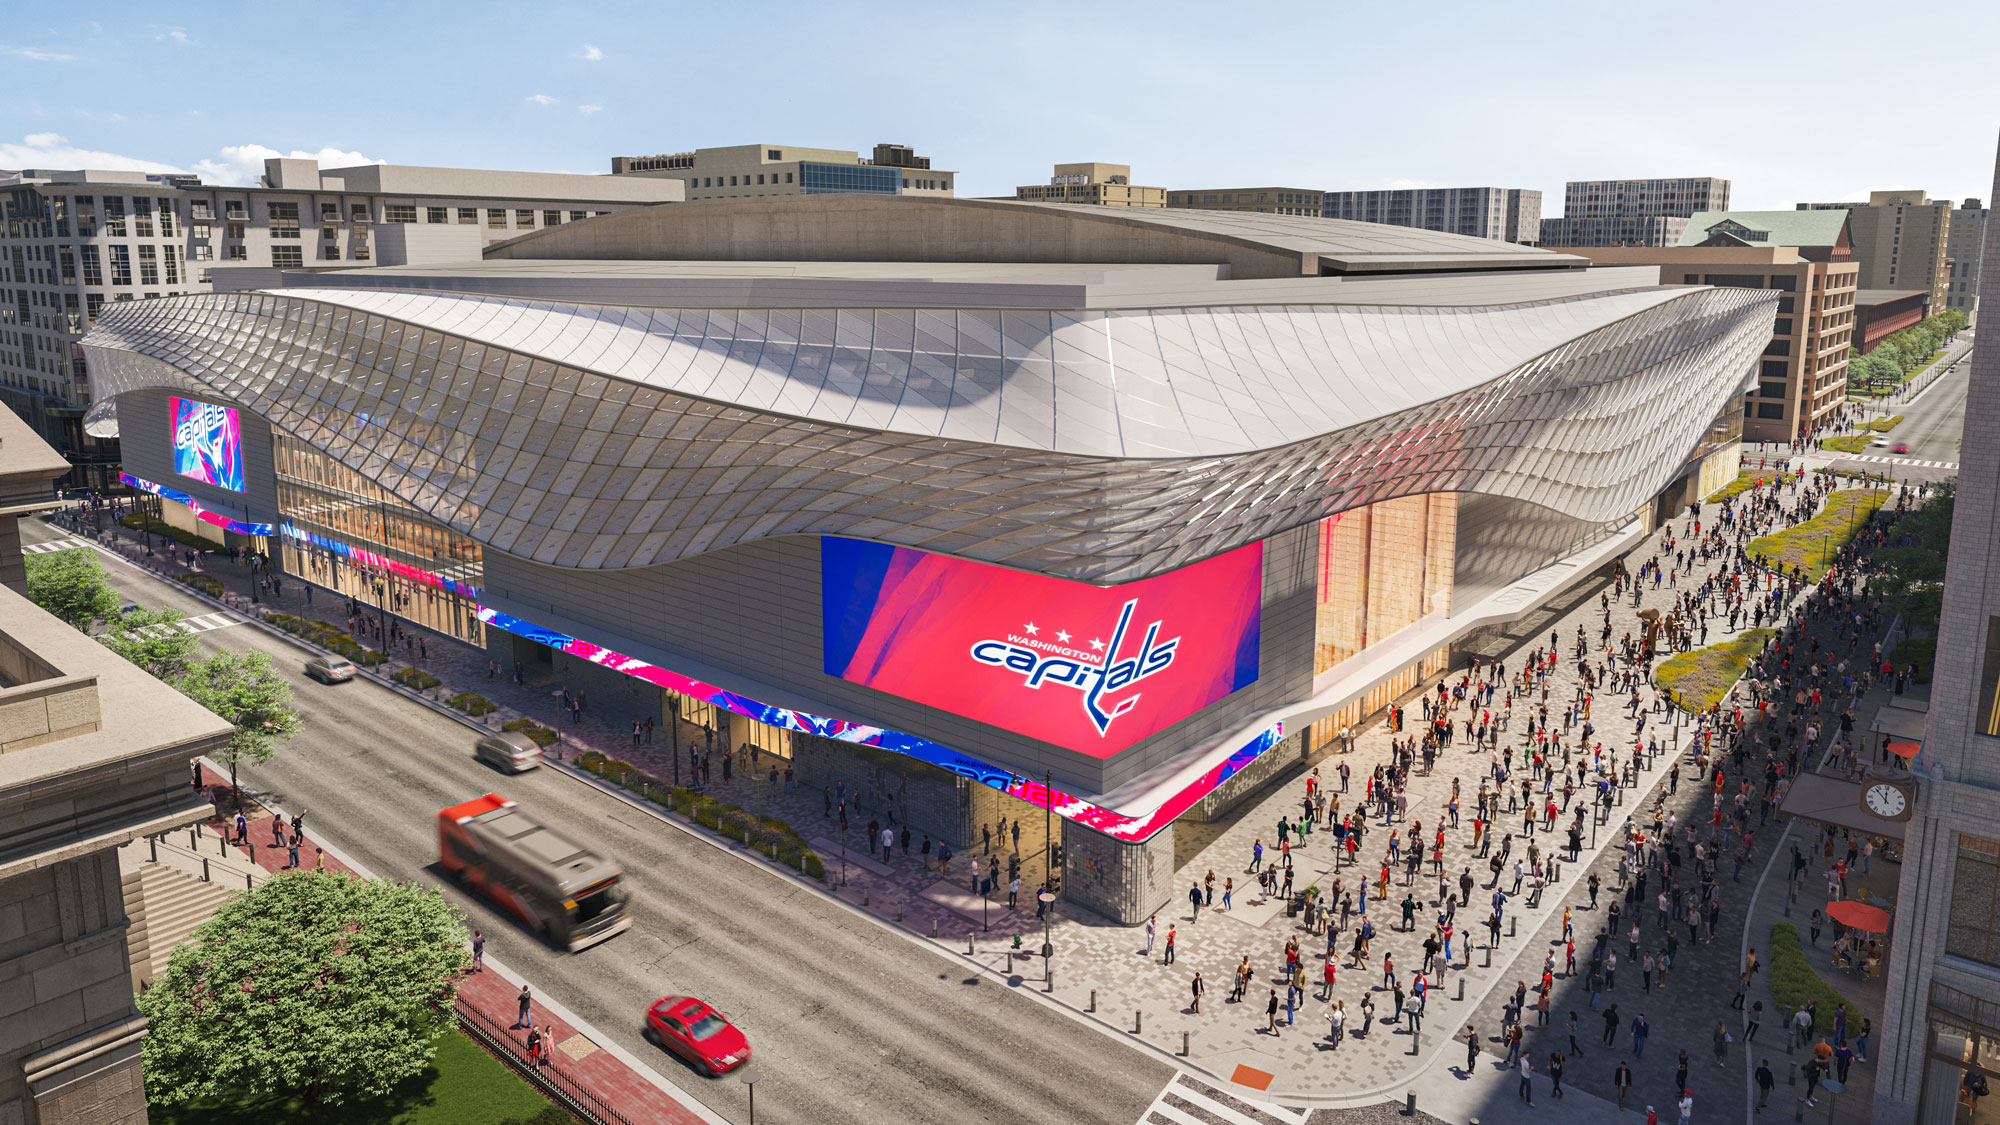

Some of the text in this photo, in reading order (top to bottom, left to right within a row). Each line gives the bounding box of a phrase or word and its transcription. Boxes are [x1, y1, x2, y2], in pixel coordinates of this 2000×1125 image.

[178, 403, 226, 453] capitals
[970, 598, 1181, 738] capitals
[1007, 633, 1102, 664] WASHINGTON
